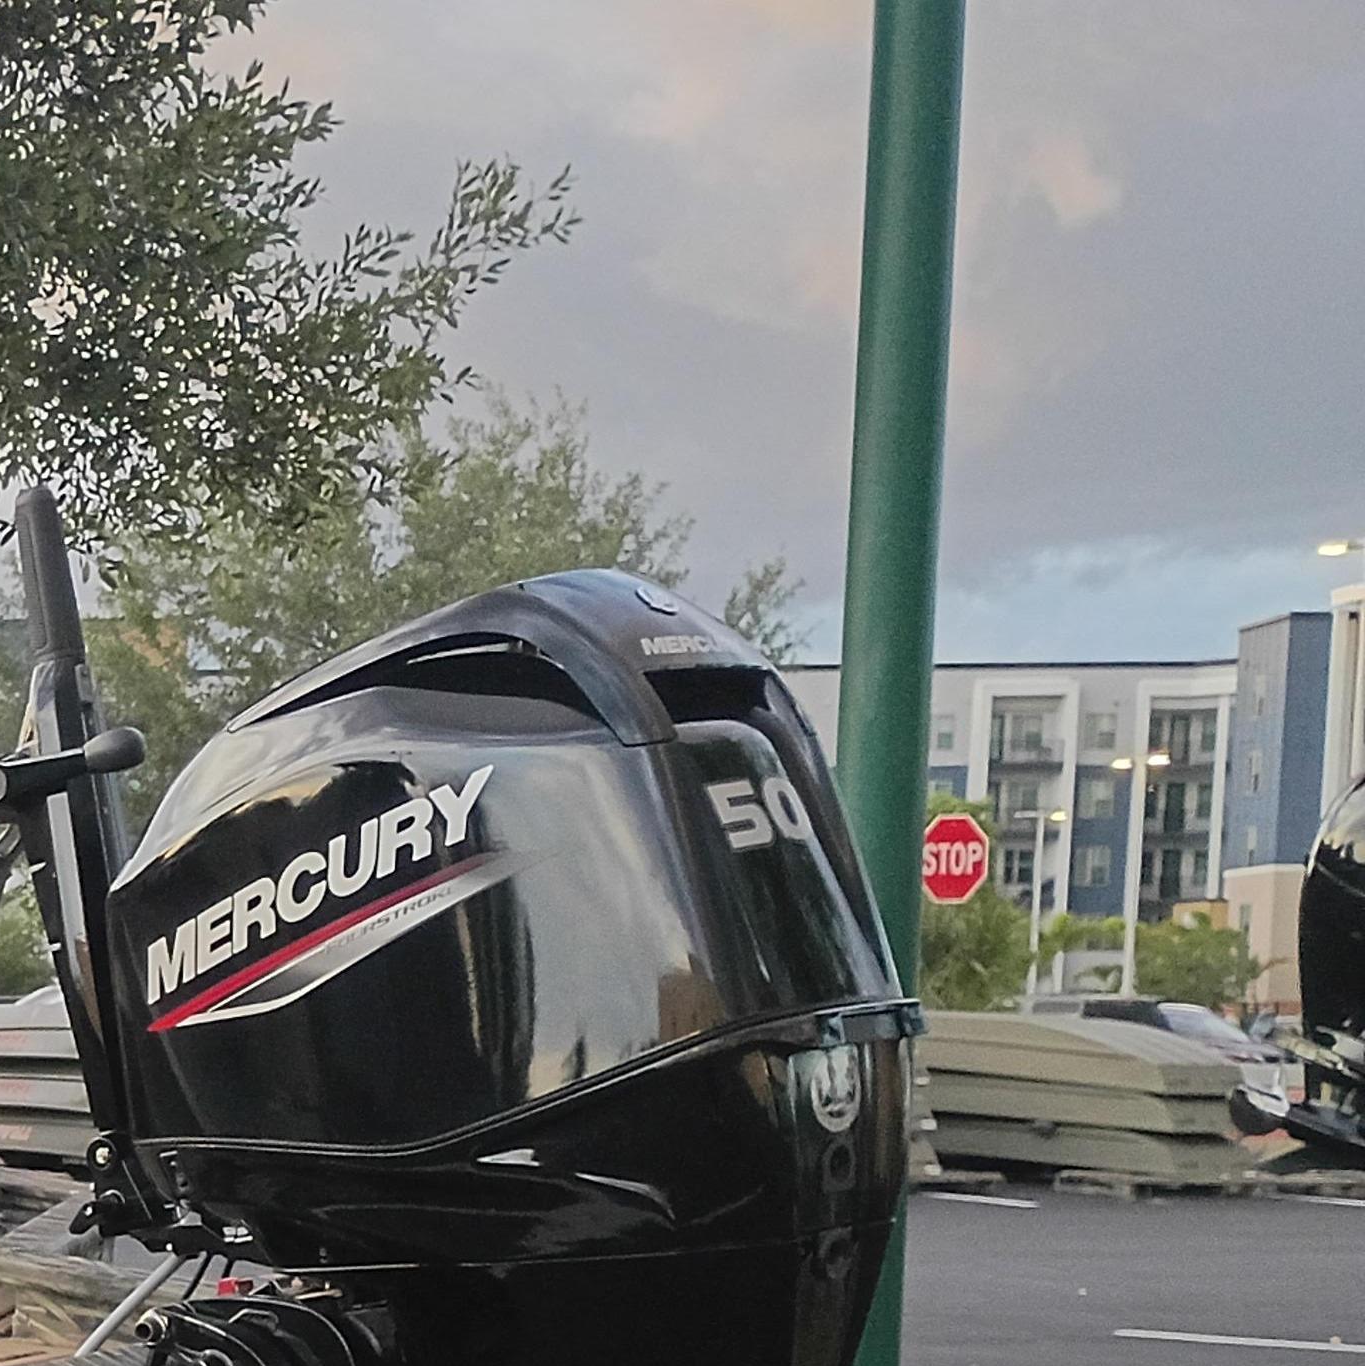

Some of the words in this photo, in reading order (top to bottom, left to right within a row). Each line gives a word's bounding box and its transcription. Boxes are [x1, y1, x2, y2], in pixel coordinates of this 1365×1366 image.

[705, 776, 811, 850] 50
[147, 764, 494, 1006] MERCURY
[922, 841, 983, 876] STOP
